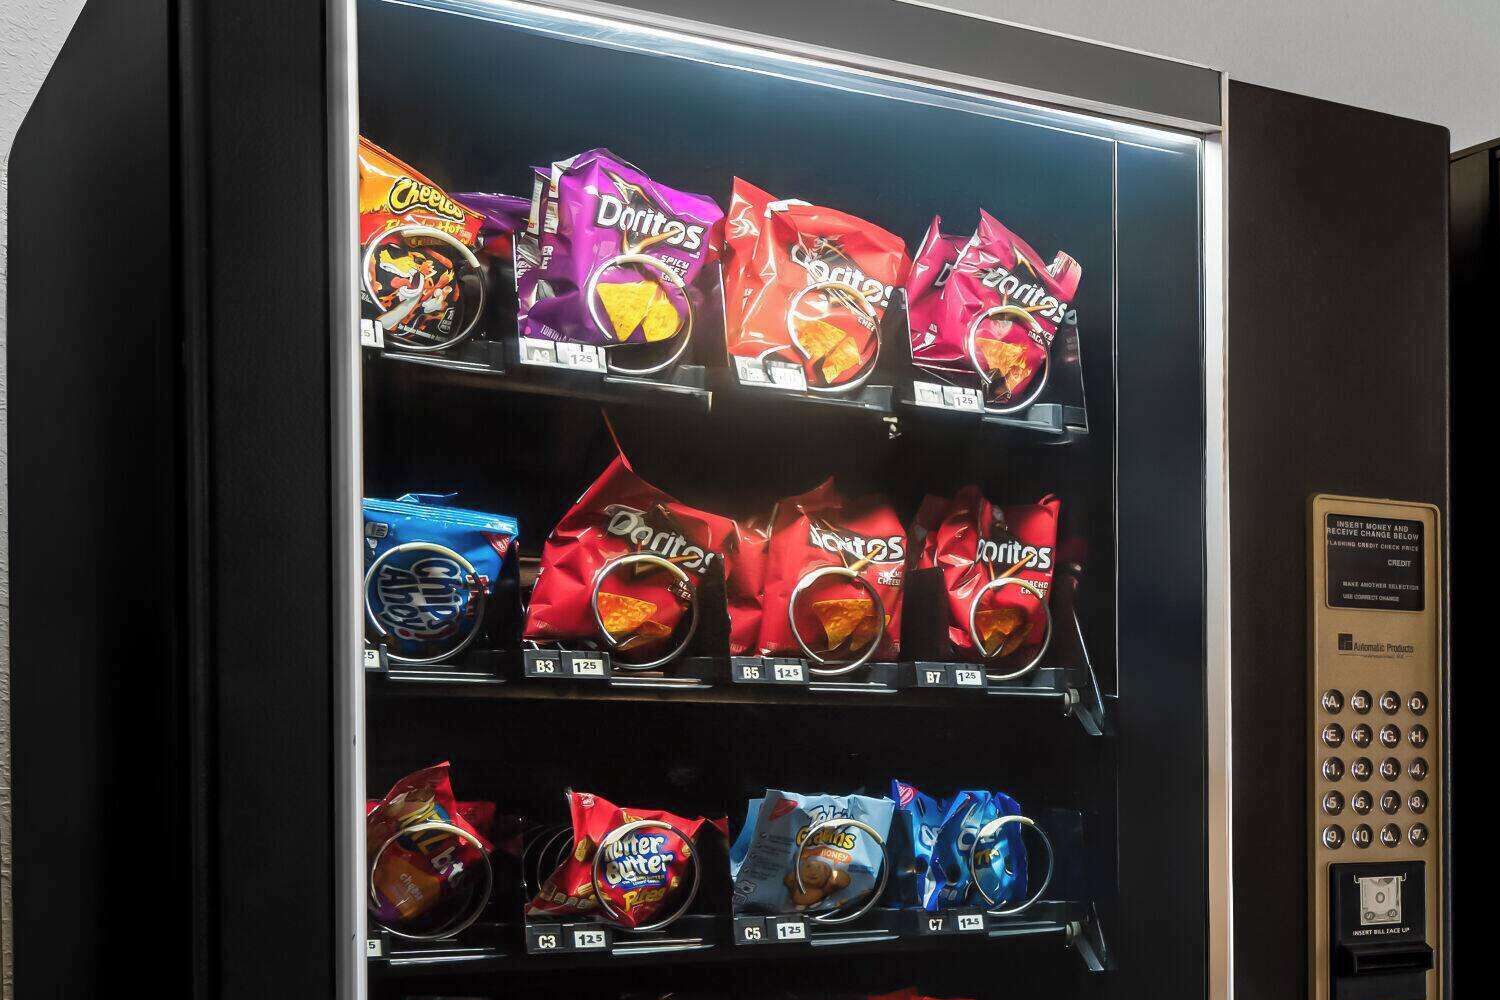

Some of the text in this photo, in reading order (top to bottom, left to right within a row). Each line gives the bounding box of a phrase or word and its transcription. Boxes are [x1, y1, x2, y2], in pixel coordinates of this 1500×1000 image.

[596, 194, 706, 251] Doritos
[982, 266, 1067, 324] Doritos
[1336, 520, 1409, 533] INSERT MONEY AND
[1327, 527, 1419, 541] RECEIVE CHANGE BELOW
[976, 538, 1052, 570] Doritos
[1387, 559, 1412, 567] CREDIT
[1353, 641, 1414, 653] Automatic Products
[535, 660, 555, 674] B3
[743, 666, 760, 679] B5
[925, 671, 941, 684] B7
[604, 834, 665, 862] Nutter
[821, 848, 849, 861] HONEY
[606, 853, 674, 885] Butter
[928, 918, 943, 931] C7
[744, 926, 762, 940] C5
[538, 934, 556, 949] C3
